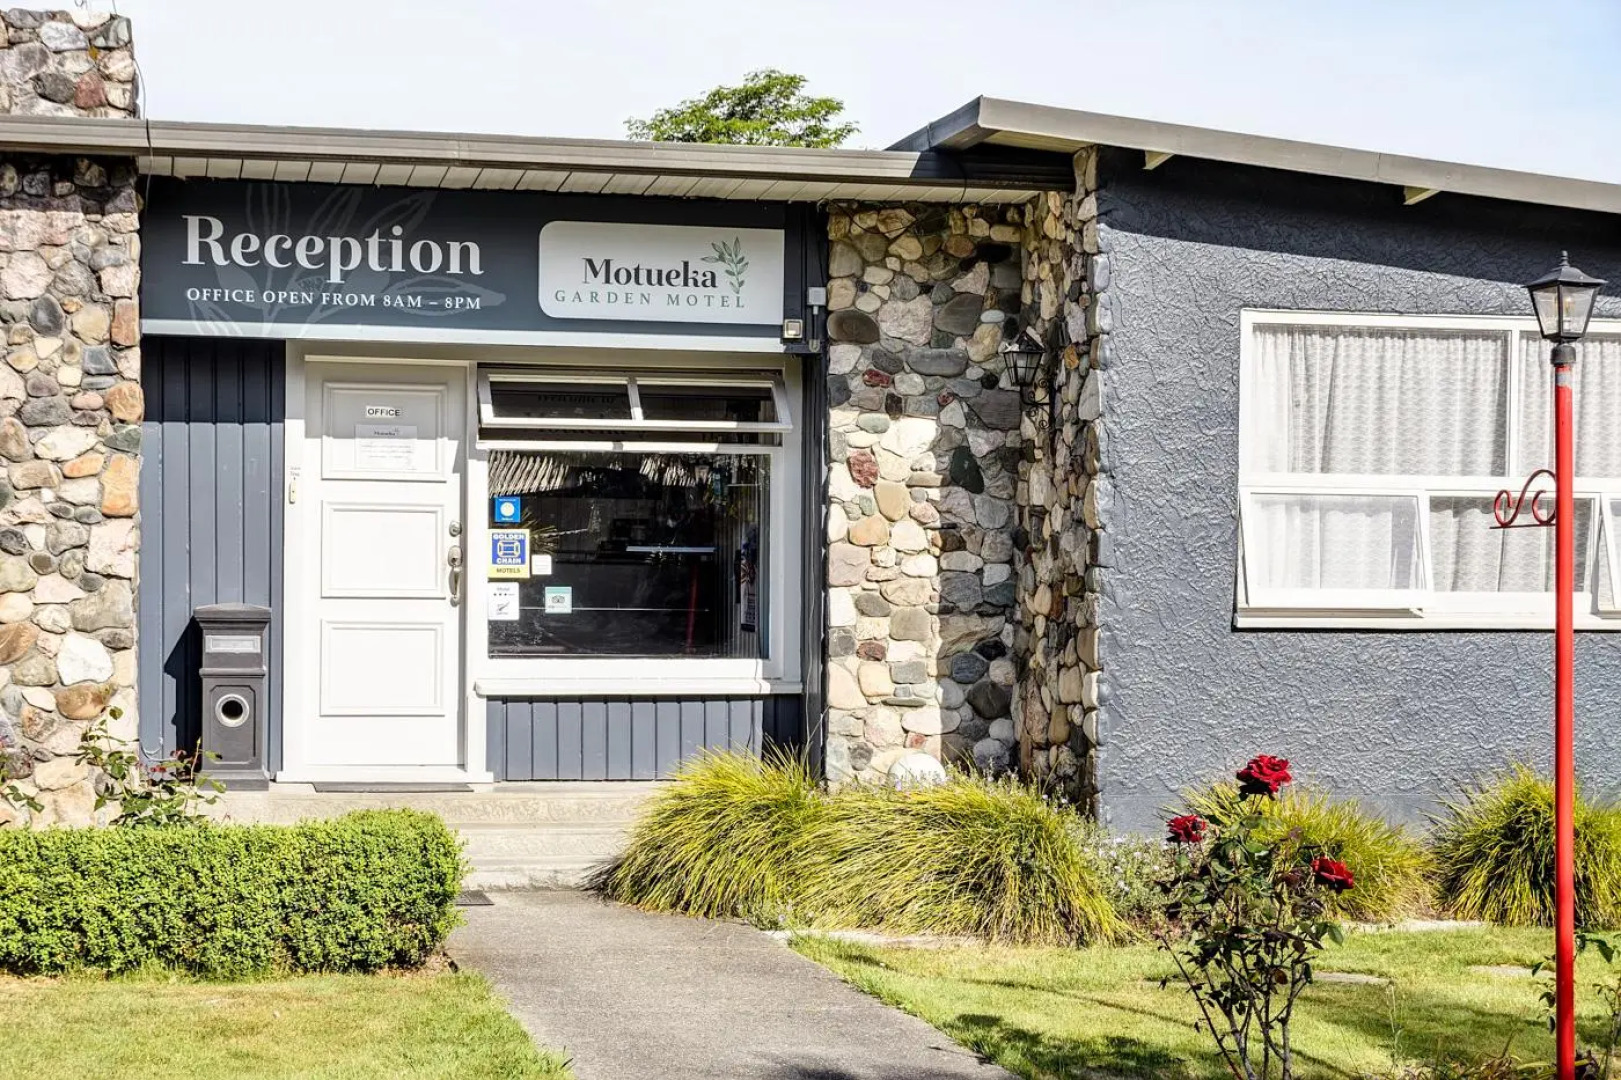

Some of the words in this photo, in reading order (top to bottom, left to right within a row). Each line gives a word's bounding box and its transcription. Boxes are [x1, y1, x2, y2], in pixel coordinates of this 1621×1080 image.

[181, 214, 485, 284] Reception
[582, 257, 718, 289] Motueka
[186, 287, 255, 303] OFFICE
[262, 290, 314, 305] OPEN
[321, 292, 376, 307] FROM
[382, 294, 422, 308] 8AM
[444, 296, 481, 310] 8PM
[554, 290, 651, 305] GARDEN
[667, 294, 745, 308] MOTEL
[367, 408, 401, 417] OFFICE
[492, 533, 525, 541] GOLDEN
[496, 557, 521, 565] CHAIN
